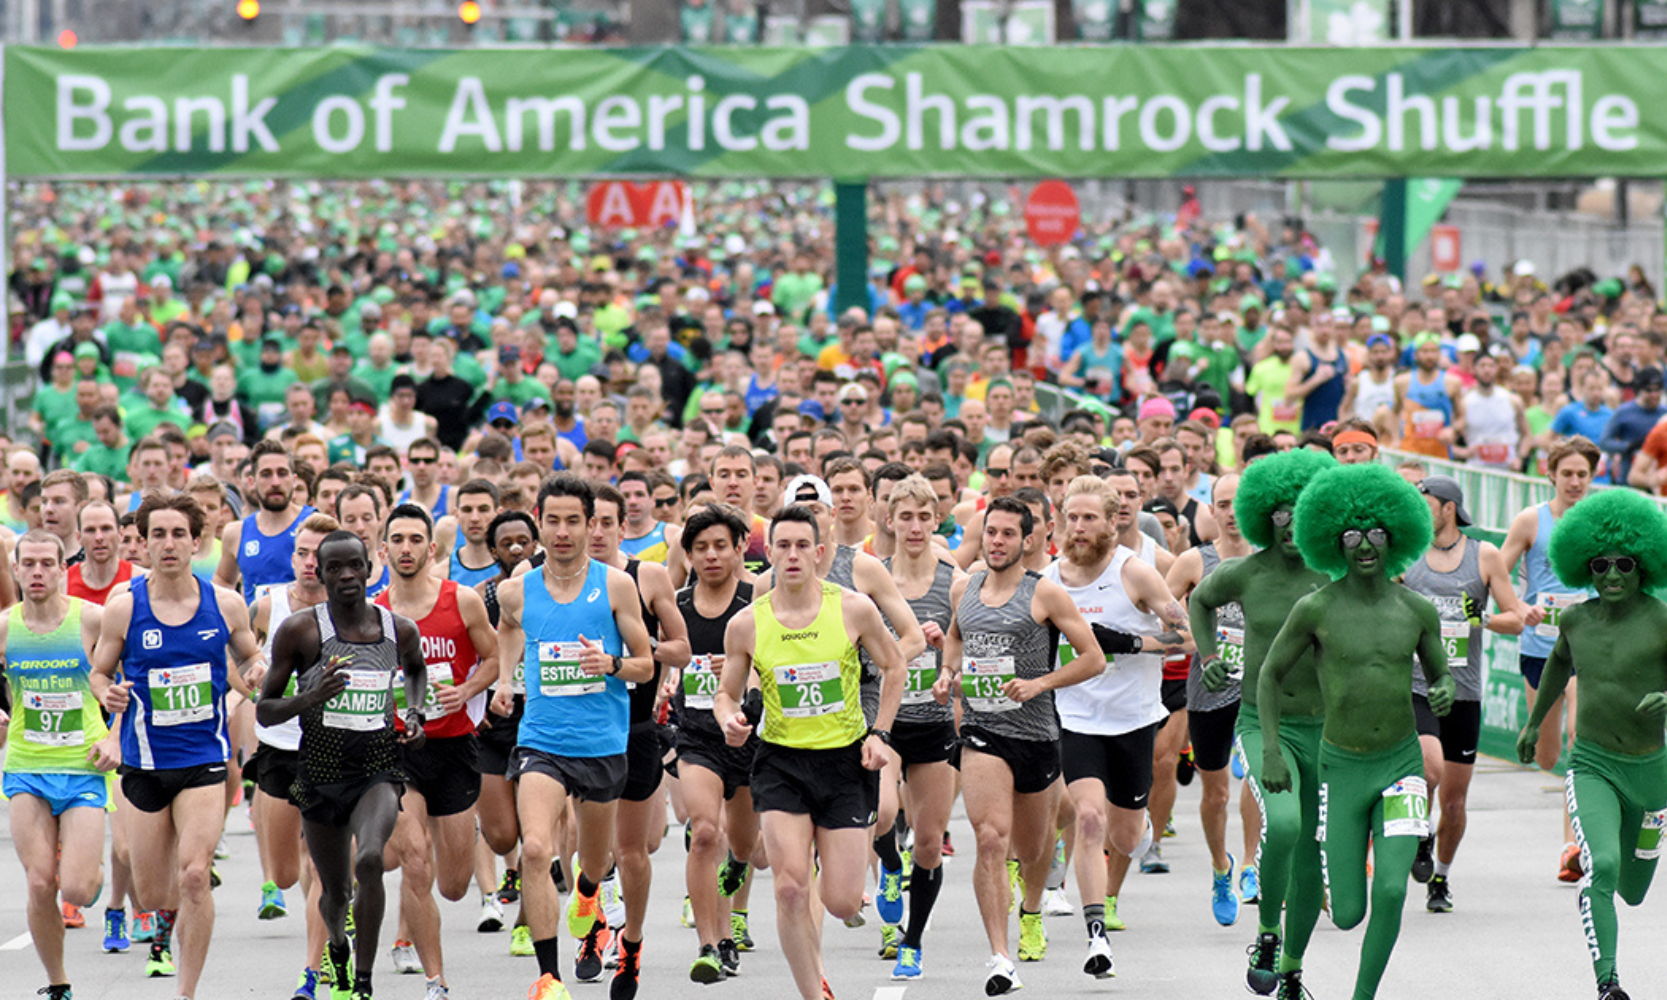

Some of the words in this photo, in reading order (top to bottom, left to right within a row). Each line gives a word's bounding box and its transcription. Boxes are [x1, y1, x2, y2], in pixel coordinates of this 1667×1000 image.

[56, 74, 281, 153] Bank
[312, 73, 410, 153] of
[438, 75, 811, 153] America
[845, 72, 1294, 152] Shamrock
[1326, 69, 1640, 152] Shuffle
[599, 180, 635, 226] A
[649, 180, 682, 227] A
[1079, 606, 1103, 614] BLAZE
[419, 635, 456, 659] OHIO
[781, 631, 820, 641] saucony
[20, 658, 79, 670] BROOKS
[541, 665, 600, 681] ESTRA
[50, 675, 74, 689] Fun
[695, 674, 718, 695] 20
[971, 676, 1004, 698] 133
[164, 685, 200, 710] 110
[325, 692, 388, 713] SAMBU
[796, 683, 824, 707] 26
[40, 710, 65, 732] 97
[1315, 782, 1329, 842] THE
[1403, 795, 1426, 819] 10
